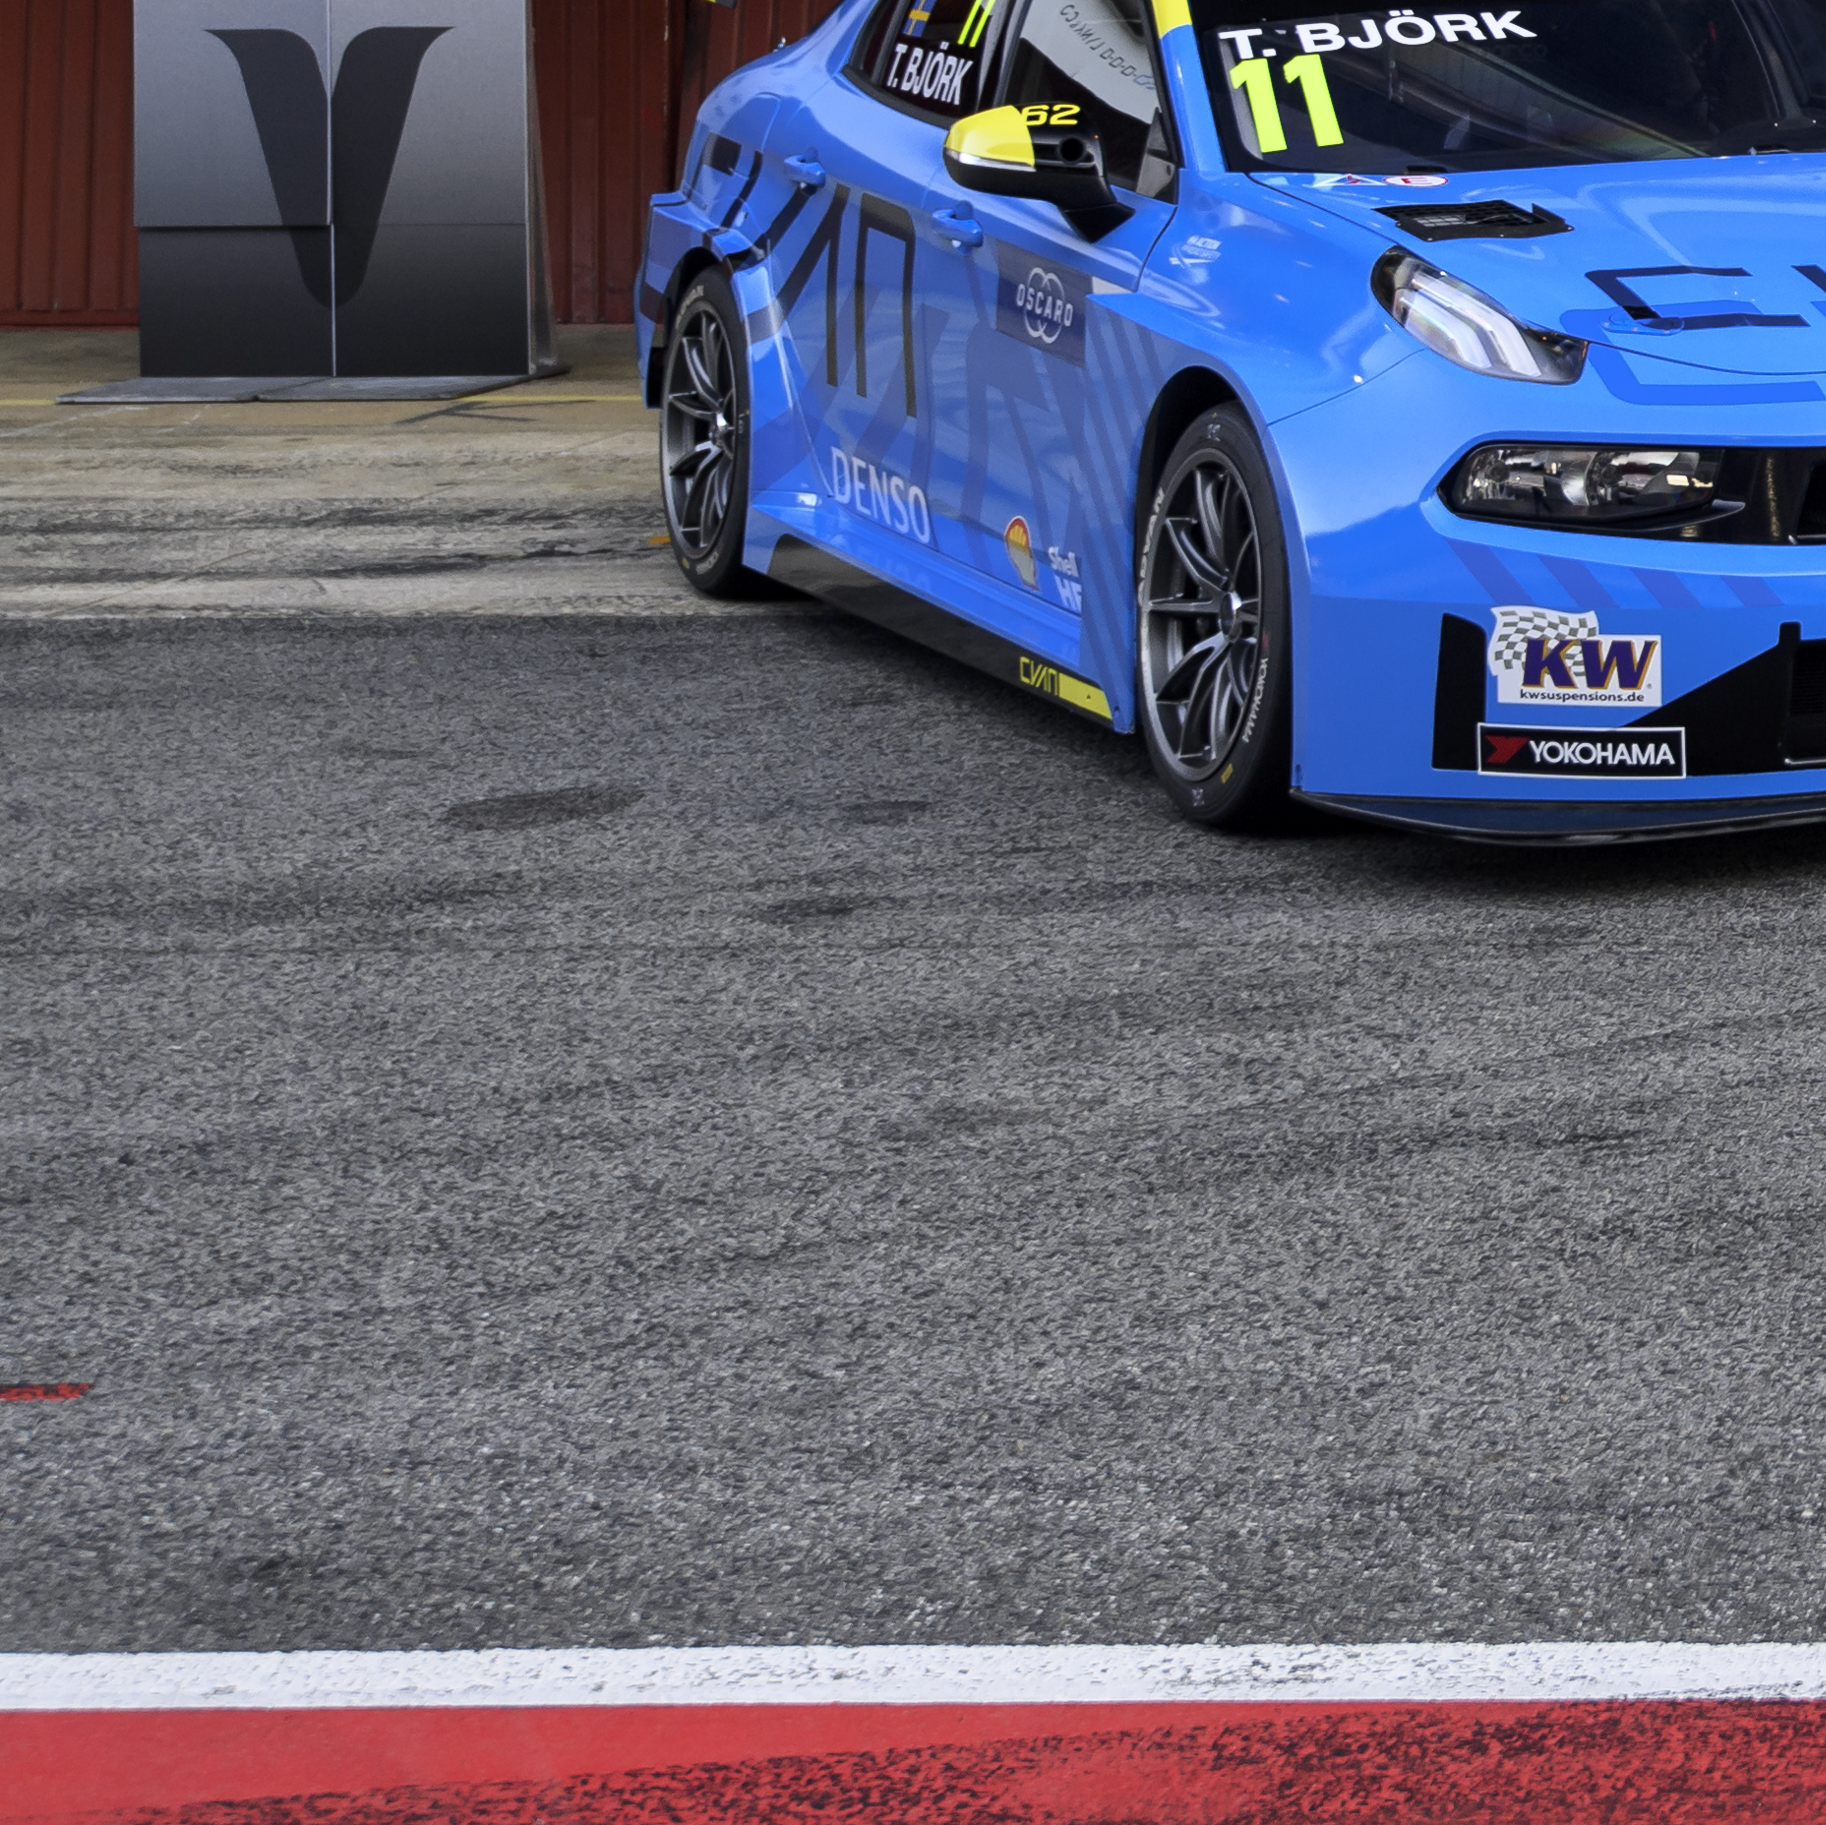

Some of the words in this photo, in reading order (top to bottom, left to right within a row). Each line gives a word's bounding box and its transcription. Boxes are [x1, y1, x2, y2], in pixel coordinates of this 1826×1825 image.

[1220, 29, 1276, 59] T.
[1295, 10, 1537, 54] BJÖRK
[887, 44, 907, 88] T.
[903, 41, 973, 106] BJÖRK
[1021, 104, 1081, 126] 62
[1228, 53, 1344, 153] 11
[1017, 283, 1074, 328] OSCARO
[831, 445, 931, 545] DENSO
[1048, 545, 1080, 578] Shell
[1020, 656, 1060, 698] CYAN
[1522, 638, 1658, 691] KW
[1520, 689, 1645, 703] kwsuspensions.de
[1529, 739, 1675, 766] YOKOHAMA
